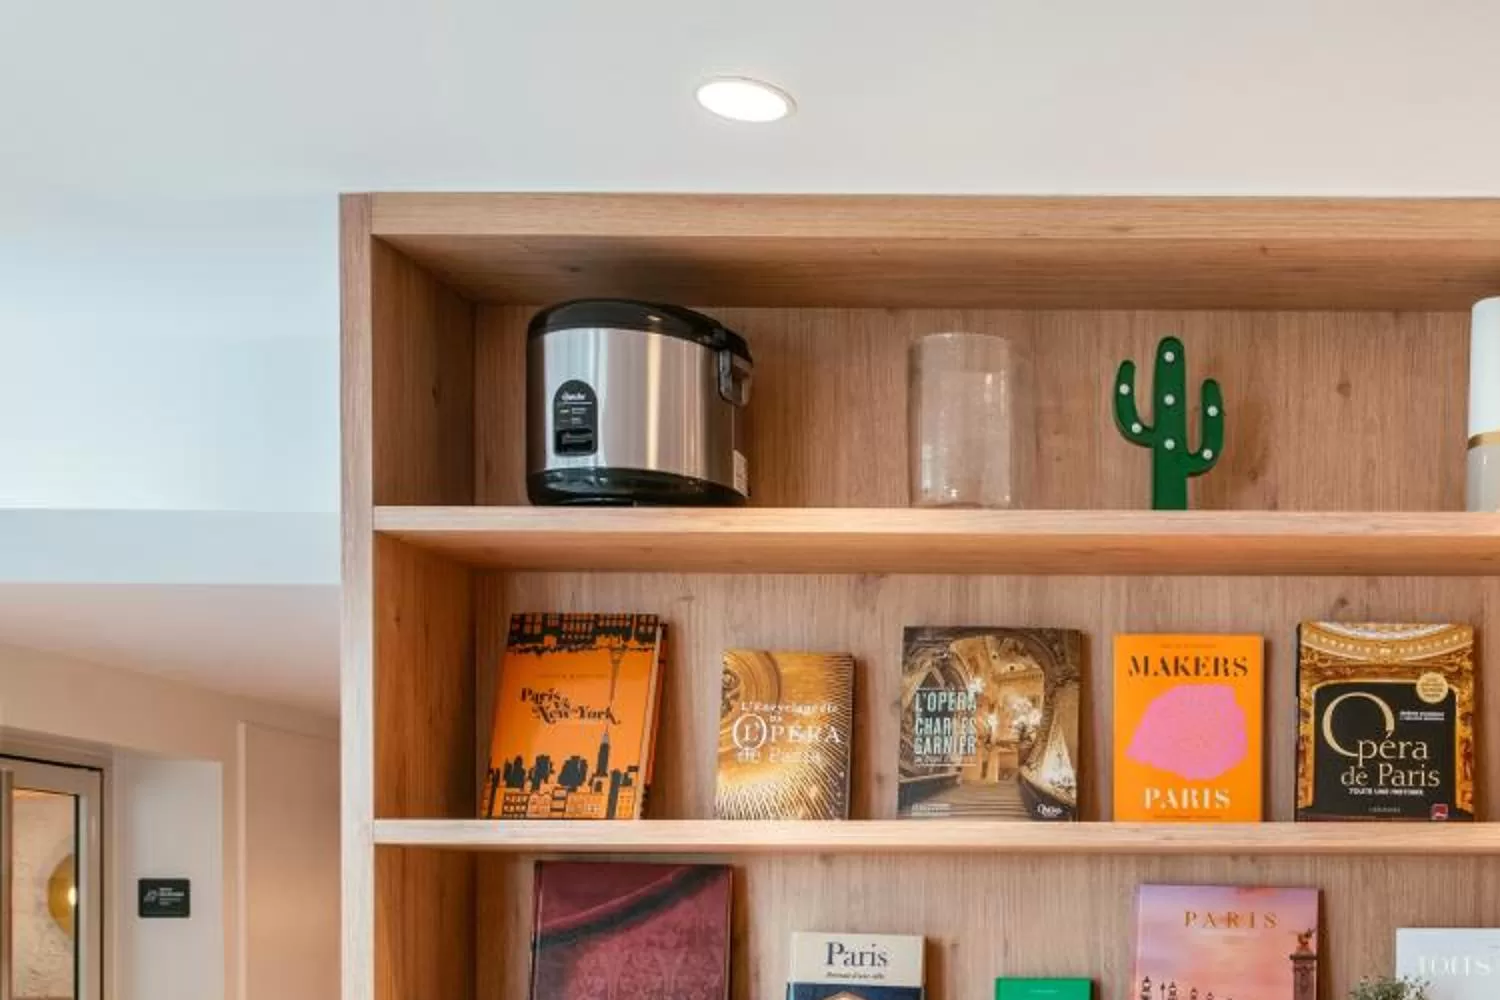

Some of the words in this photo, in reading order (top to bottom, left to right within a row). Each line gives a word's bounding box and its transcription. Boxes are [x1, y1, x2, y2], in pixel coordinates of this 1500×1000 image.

[1128, 655, 1248, 677] MAKERS
[521, 687, 560, 705] Paris
[914, 716, 977, 736] CHARLES
[1322, 692, 1430, 769] Opéra
[913, 736, 977, 755] GARNIER
[1340, 765, 1369, 787] de
[1378, 762, 1441, 787] Paris
[1144, 786, 1231, 809] PARIS
[1184, 911, 1278, 929] PARIS
[826, 941, 888, 967] Paris
